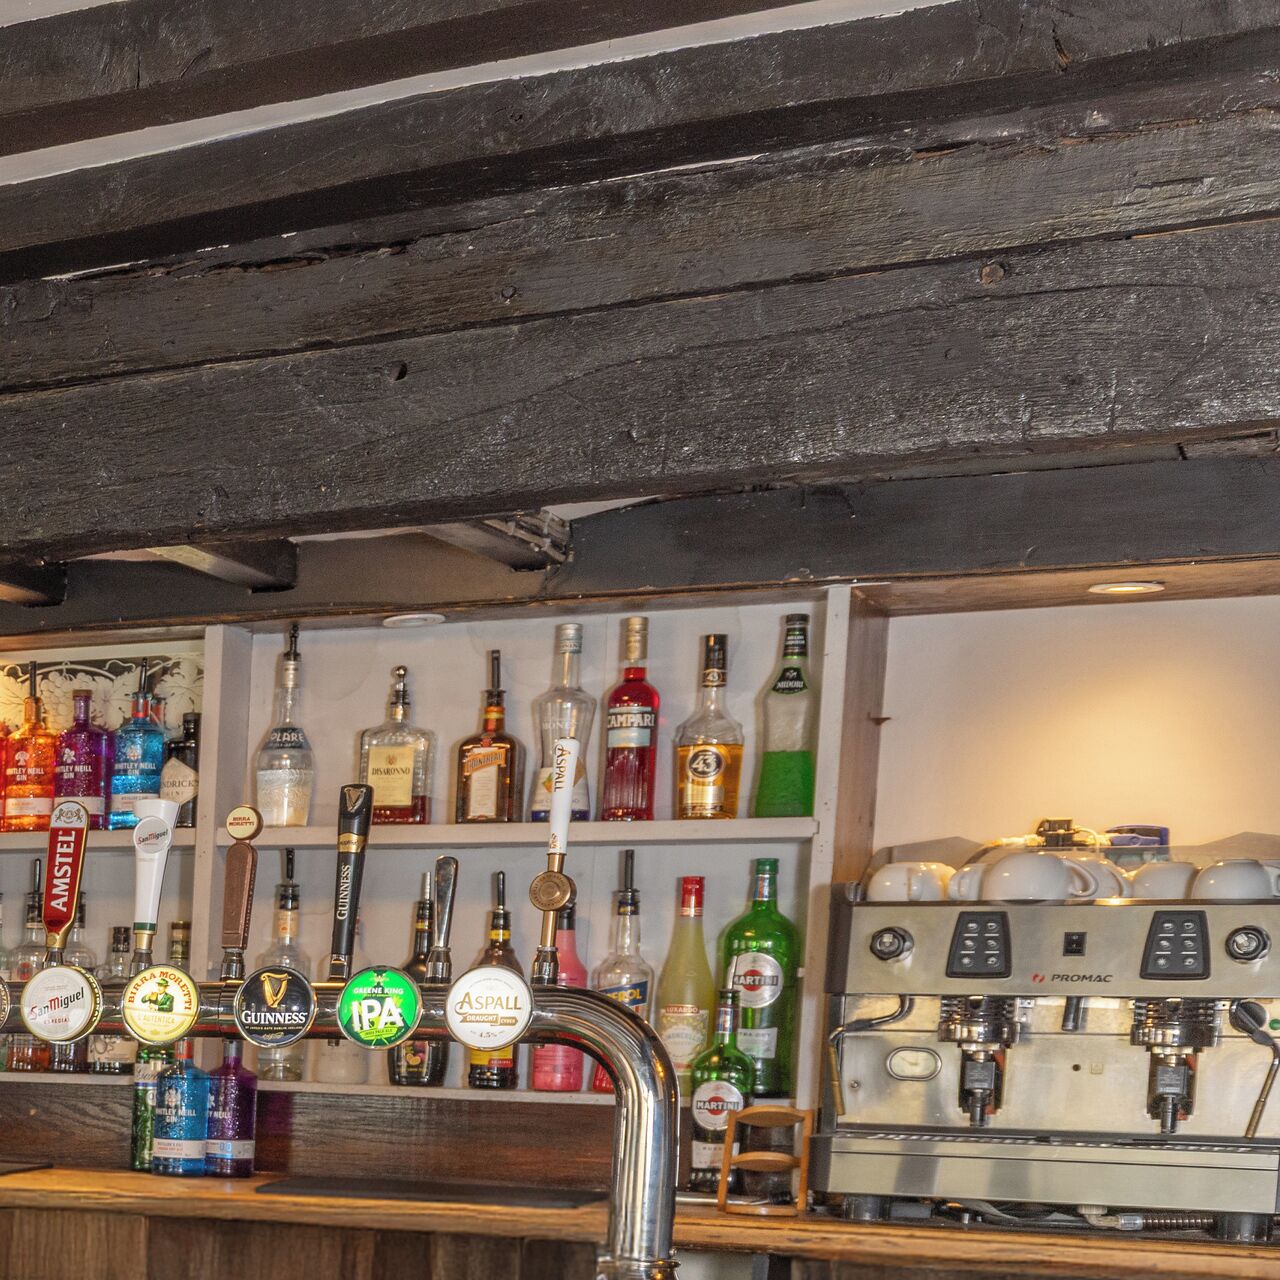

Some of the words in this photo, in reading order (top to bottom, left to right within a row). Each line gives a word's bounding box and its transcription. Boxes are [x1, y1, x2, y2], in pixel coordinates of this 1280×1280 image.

[607, 713, 655, 728] CAMPARI
[554, 744, 571, 792] ASPALL
[691, 753, 717, 772] 43
[50, 831, 76, 912] AMSTEL
[336, 864, 351, 920] GUINNESS
[1051, 974, 1113, 983] PROMAC
[128, 972, 157, 1003] BIRRA
[158, 971, 192, 1011] MORETTI
[455, 992, 522, 1015] ASPALL
[242, 1010, 307, 1025] GUINNESS
[352, 997, 405, 1032] IPA
[466, 1014, 497, 1022] DRAUGHT
[178, 1109, 196, 1117] NEILL
[696, 1101, 739, 1110] MARTINI
